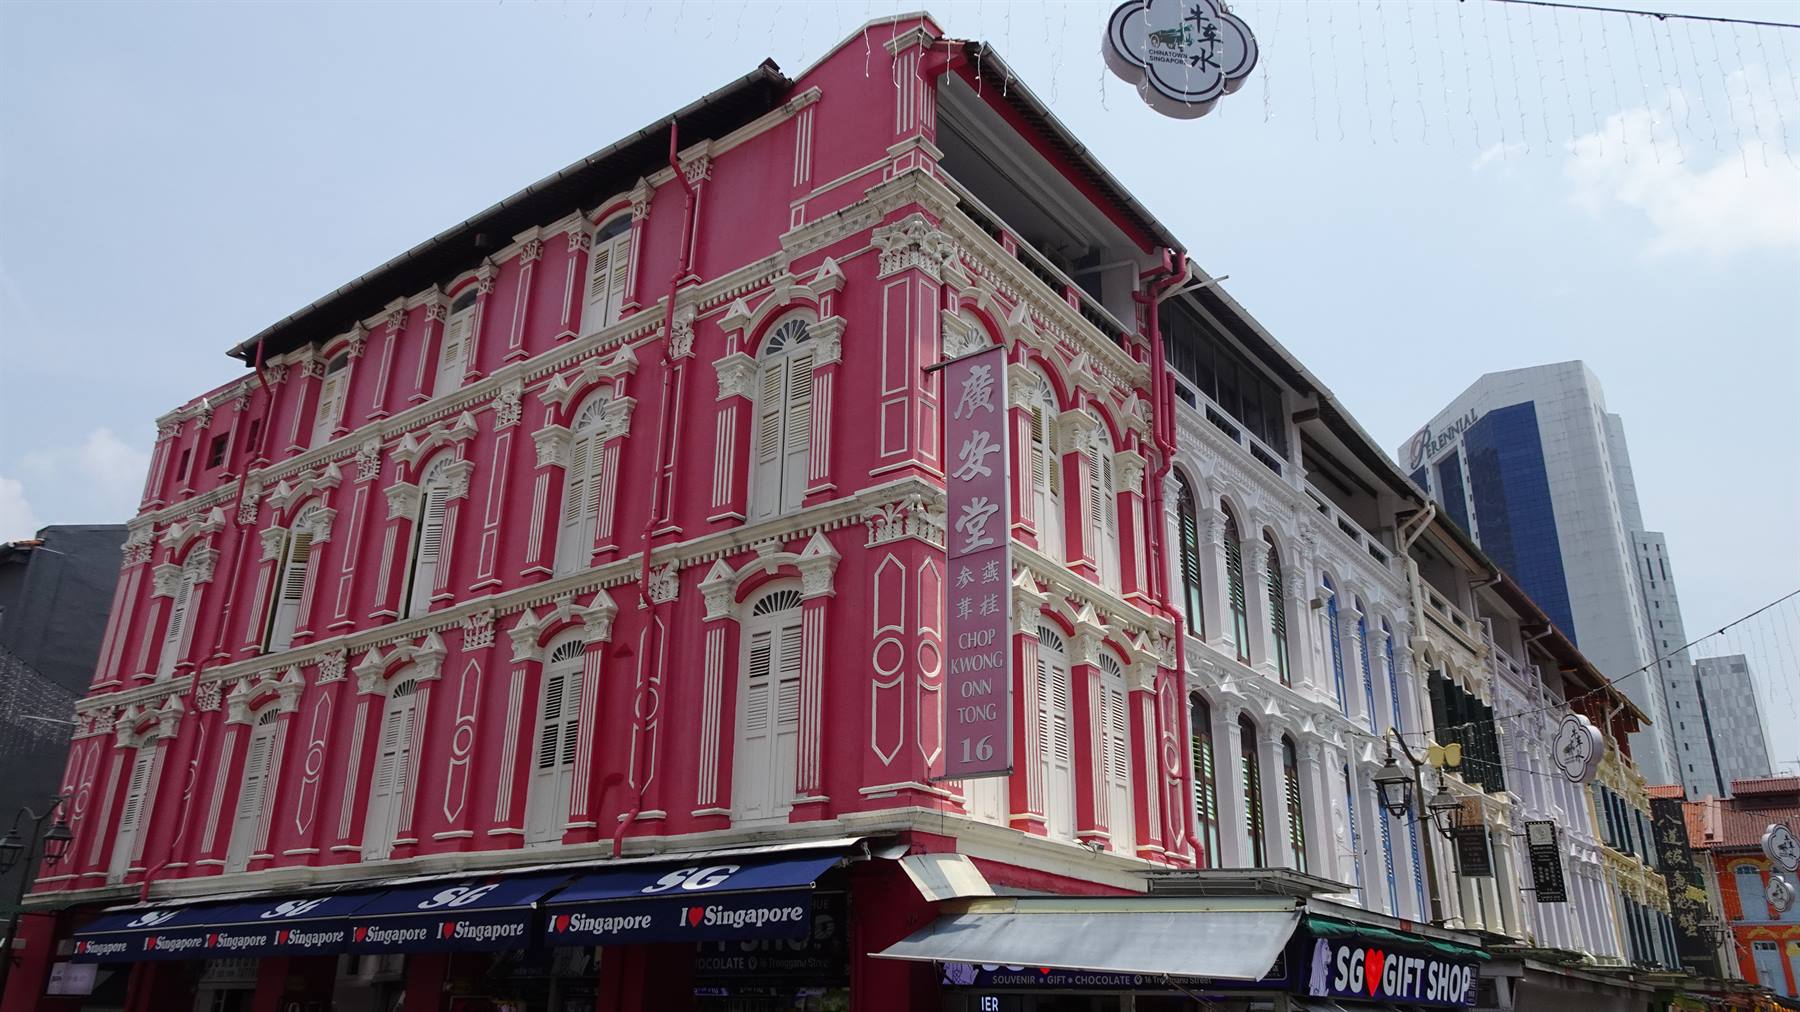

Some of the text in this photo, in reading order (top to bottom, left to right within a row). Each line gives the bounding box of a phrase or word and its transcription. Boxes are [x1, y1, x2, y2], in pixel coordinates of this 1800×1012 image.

[1148, 49, 1189, 59] CHINATOWN
[1410, 408, 1479, 470] PERENNIAL
[952, 364, 1001, 553] 廣安堂
[958, 628, 996, 650] CHOP
[950, 651, 1004, 675] KWONG
[961, 679, 993, 699] ONN
[956, 703, 998, 724] TONG
[959, 734, 993, 764] 16
[641, 865, 741, 894] SG
[417, 883, 500, 909] SG
[260, 896, 333, 919] SG
[680, 905, 803, 928] I Singapore
[436, 921, 524, 941] I Singapore
[548, 913, 651, 934] I Singapore
[143, 936, 202, 952] I Singapore
[204, 932, 267, 950] I Singapore
[274, 929, 344, 947] I Singapore
[365, 926, 427, 944] Singapore
[74, 941, 127, 955] I Singapore
[992, 975, 1036, 985] SOUVENIR
[1047, 975, 1067, 985] GIFT
[1074, 975, 1131, 986] CHOCOLATE
[1334, 946, 1365, 993] SG
[1383, 954, 1424, 998] GIFT
[1427, 961, 1471, 1003] SHOP
[981, 996, 999, 1012] IER
